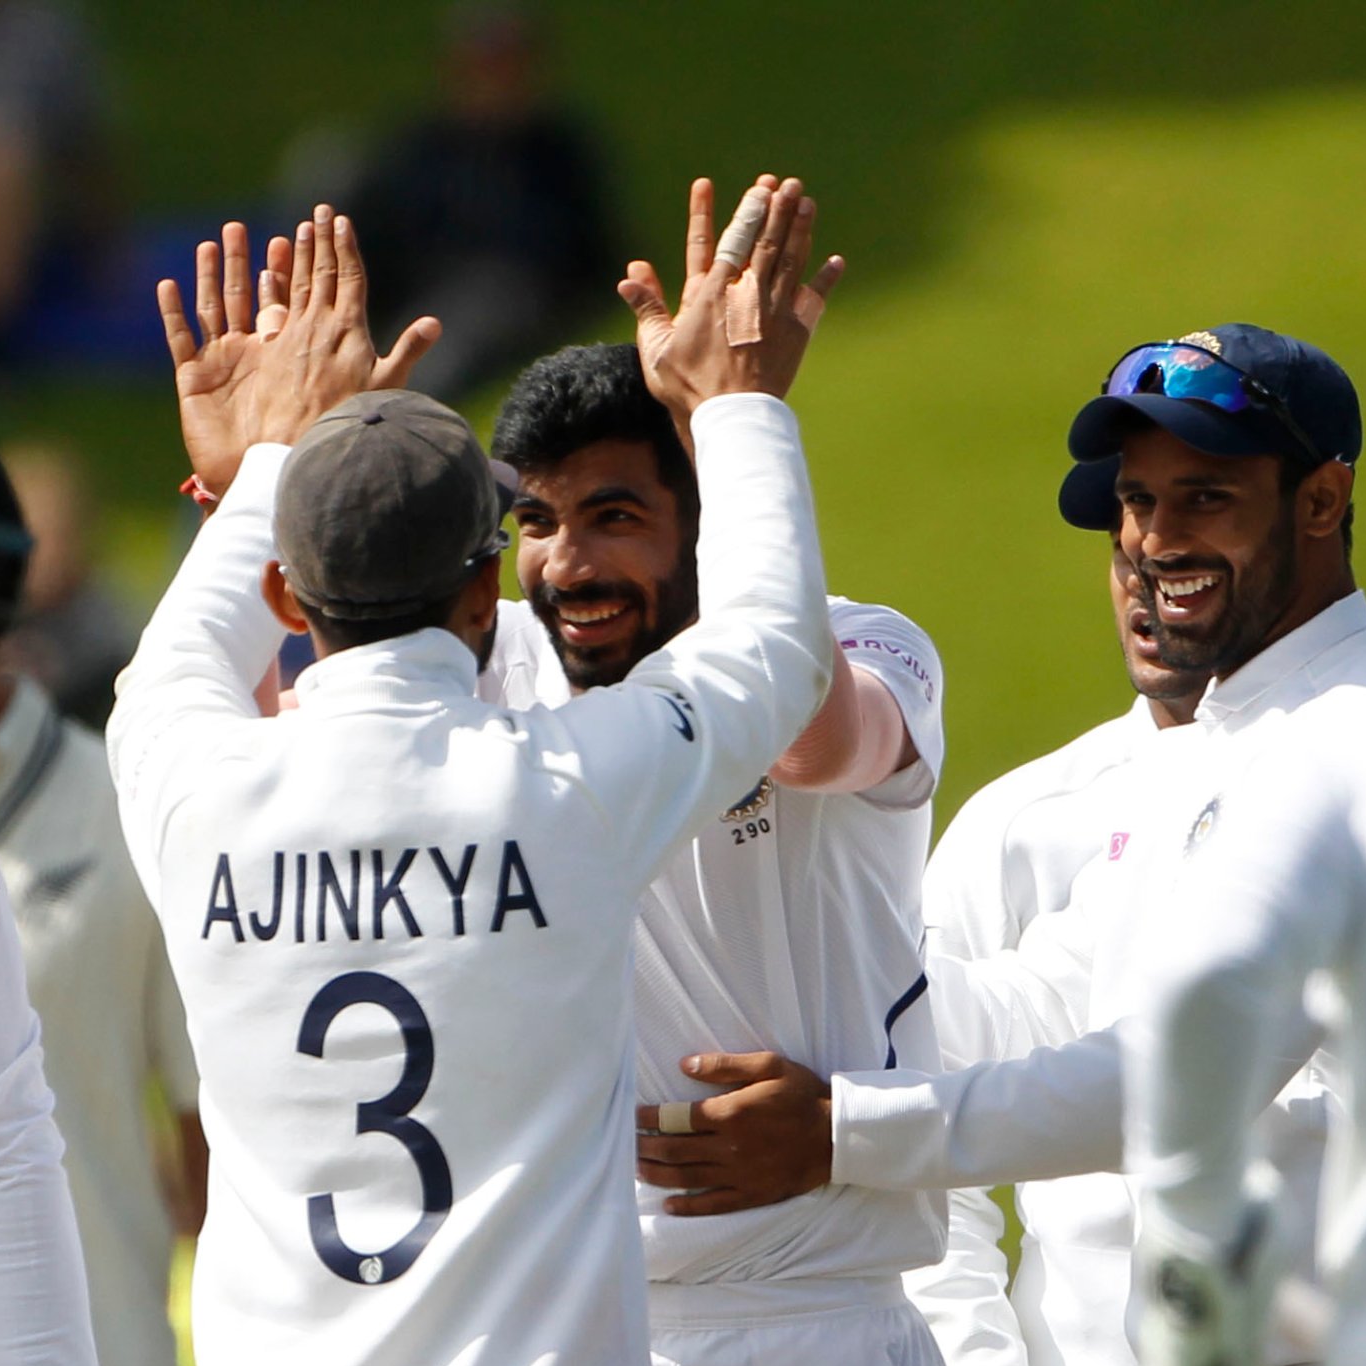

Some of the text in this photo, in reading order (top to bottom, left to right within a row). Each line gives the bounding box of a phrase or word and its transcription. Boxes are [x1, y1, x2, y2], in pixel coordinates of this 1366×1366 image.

[731, 817, 771, 846] 290
[201, 840, 549, 943] AJINKYA
[296, 970, 453, 1286] 3
